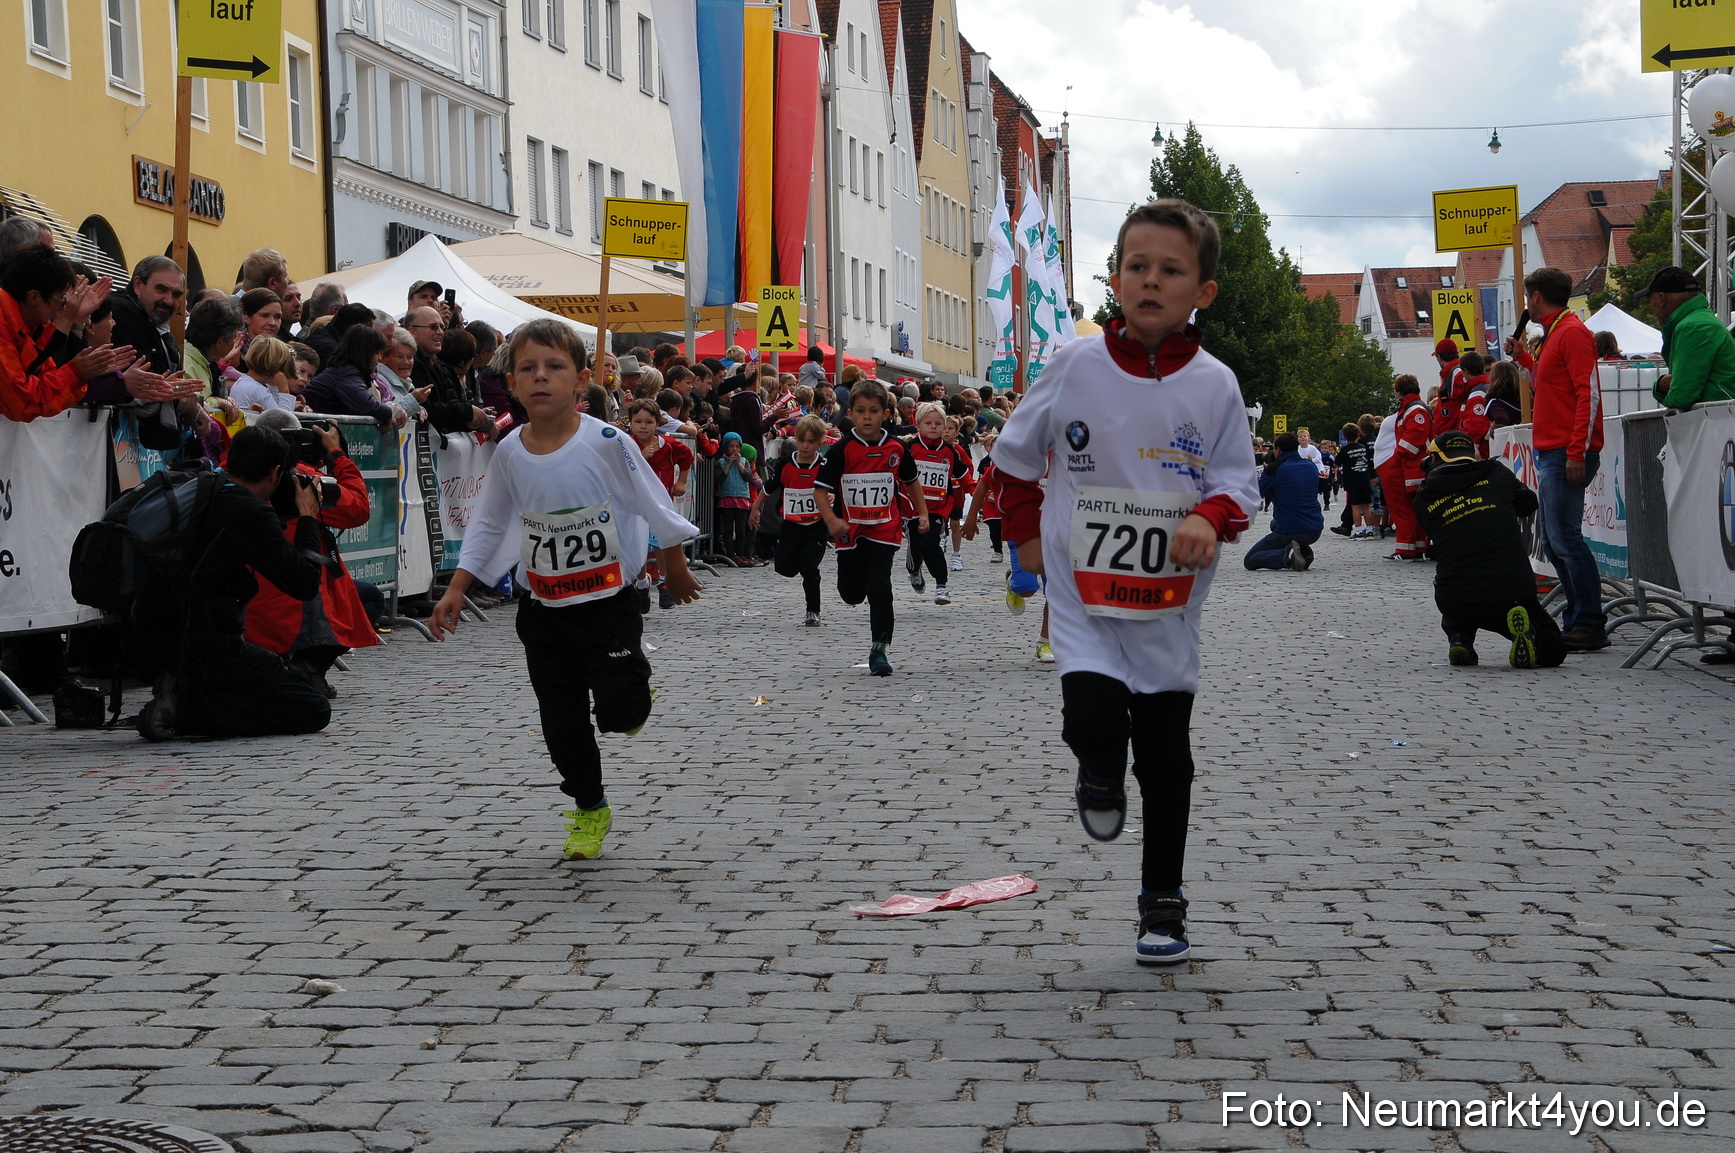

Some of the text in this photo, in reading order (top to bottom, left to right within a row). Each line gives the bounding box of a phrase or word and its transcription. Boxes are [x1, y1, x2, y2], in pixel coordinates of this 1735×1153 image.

[210, 0, 254, 21] lauf
[420, 13, 454, 56] WEBER
[189, 178, 226, 221] ANTO
[1439, 205, 1512, 221] Schnupper-
[610, 214, 681, 231] Schnupper-
[1464, 221, 1488, 236] lauf
[633, 232, 657, 245] lauf
[763, 288, 795, 301] Block
[1438, 292, 1473, 305] Block
[765, 305, 790, 337] A
[1444, 309, 1470, 342] A
[1277, 420, 1284, 430] C
[1068, 455, 1095, 464] PARTL
[1067, 465, 1096, 473] Neumarkt
[789, 498, 818, 513] 719
[848, 487, 888, 506] 7173
[1453, 495, 1465, 504] an
[1077, 499, 1189, 519] PARTL Neumarkt
[1442, 496, 1483, 518] einem Tag
[523, 517, 595, 534] PARTL Neumarkt
[528, 529, 607, 571] 7129
[1086, 522, 1182, 574] 720
[537, 572, 604, 596] Christoph
[1104, 581, 1162, 604] Jonas
